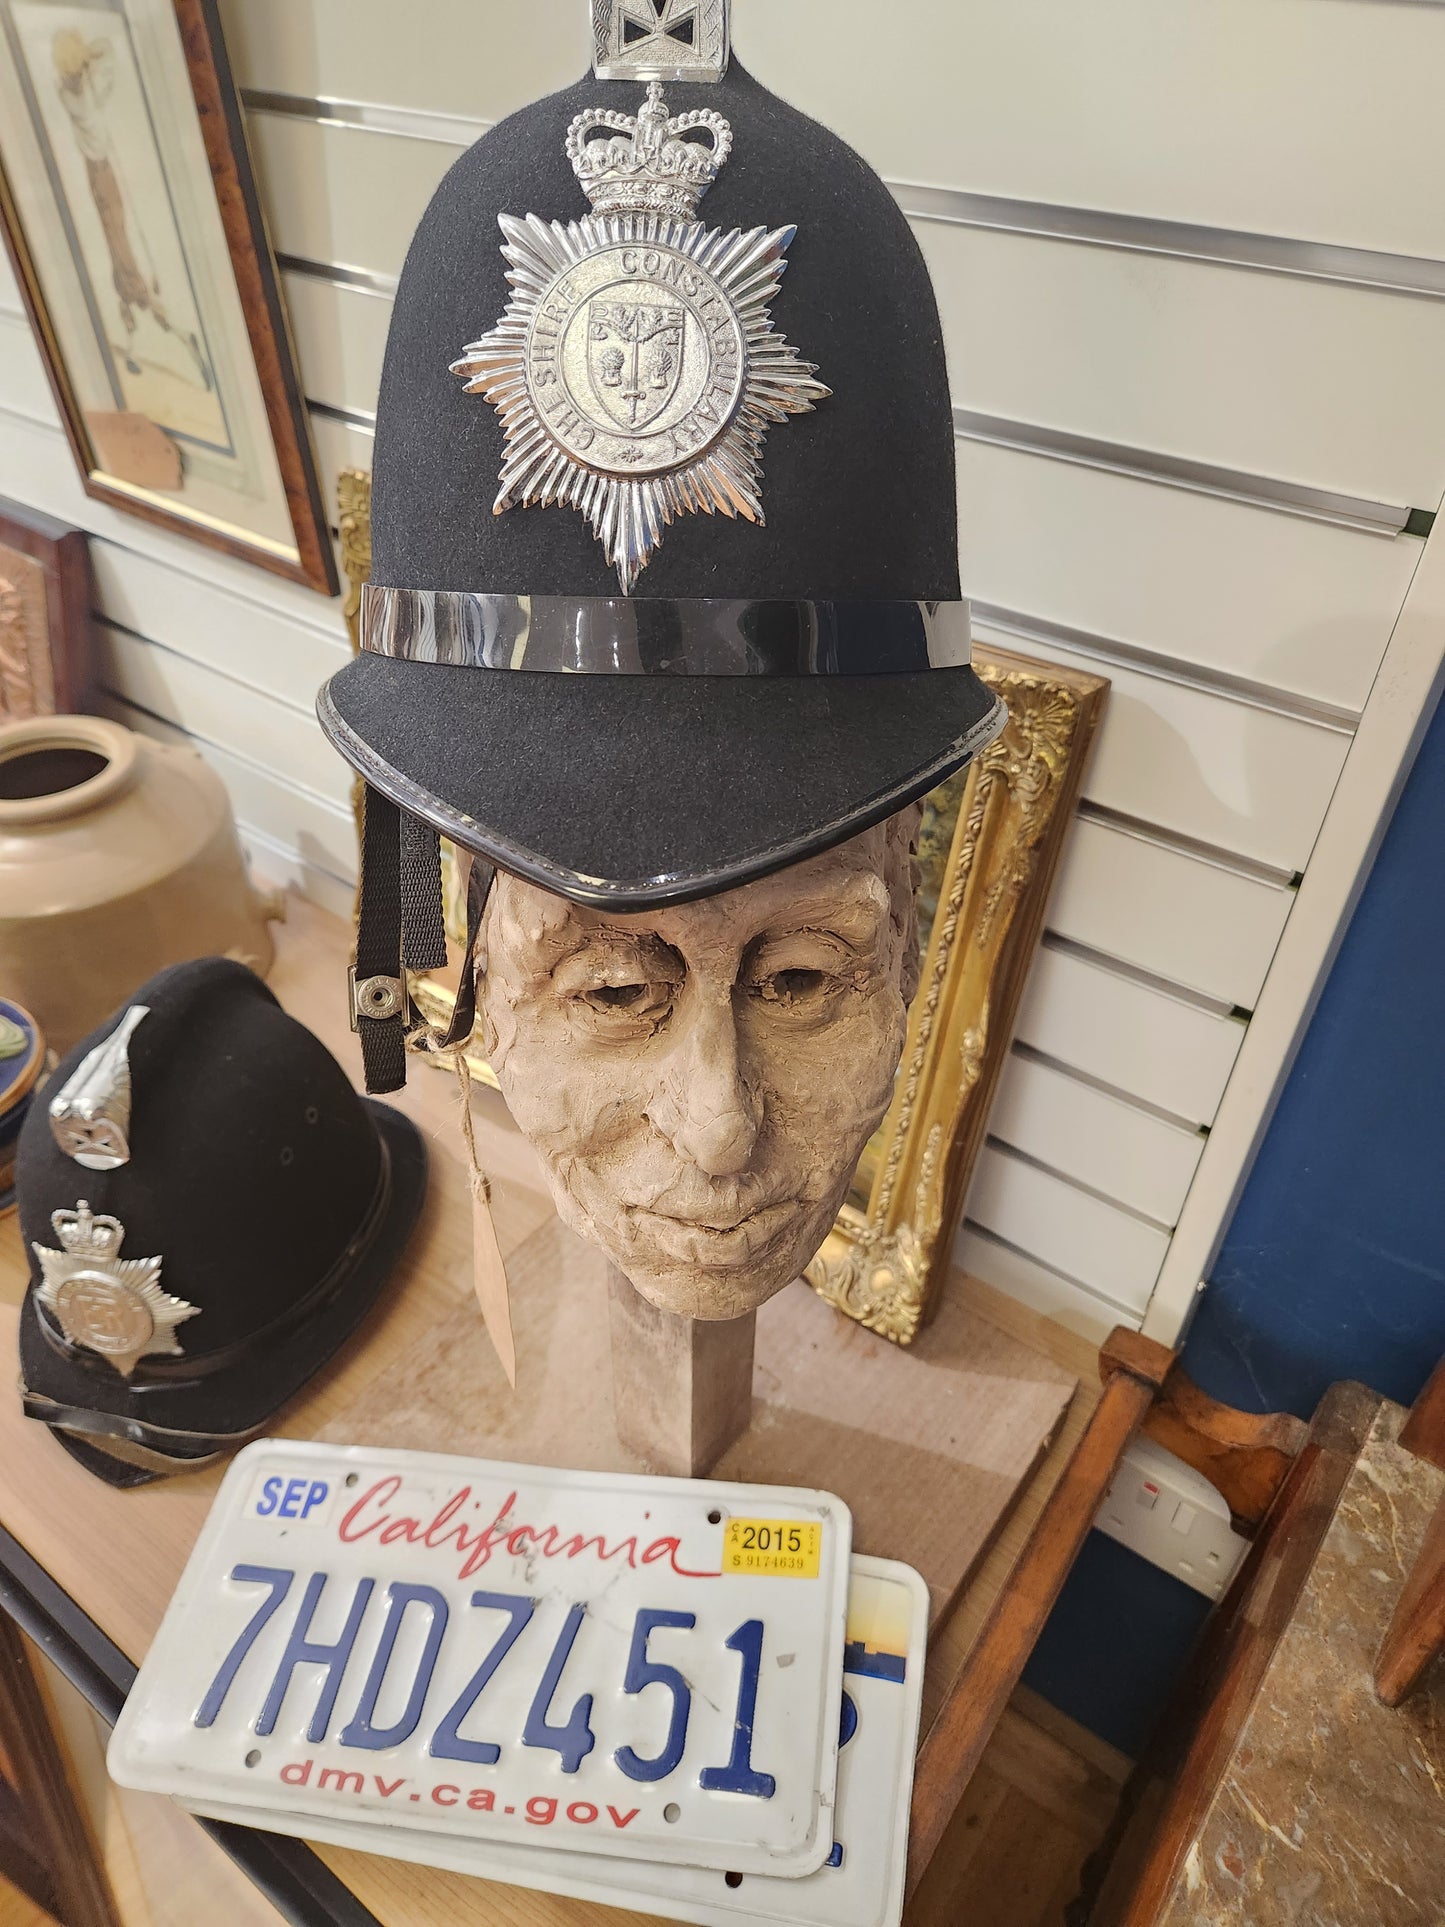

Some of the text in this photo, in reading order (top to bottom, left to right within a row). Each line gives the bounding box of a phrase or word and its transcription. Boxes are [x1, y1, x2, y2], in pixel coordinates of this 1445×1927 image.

[531, 251, 736, 459] CHESHIRE CONSTABULARY
[255, 1475, 328, 1519] SEP
[338, 1475, 722, 1579] California
[742, 1526, 801, 1552] 2015
[193, 1563, 777, 1799] 7HDZ451
[279, 1759, 641, 1828] dmv.ca.gov
